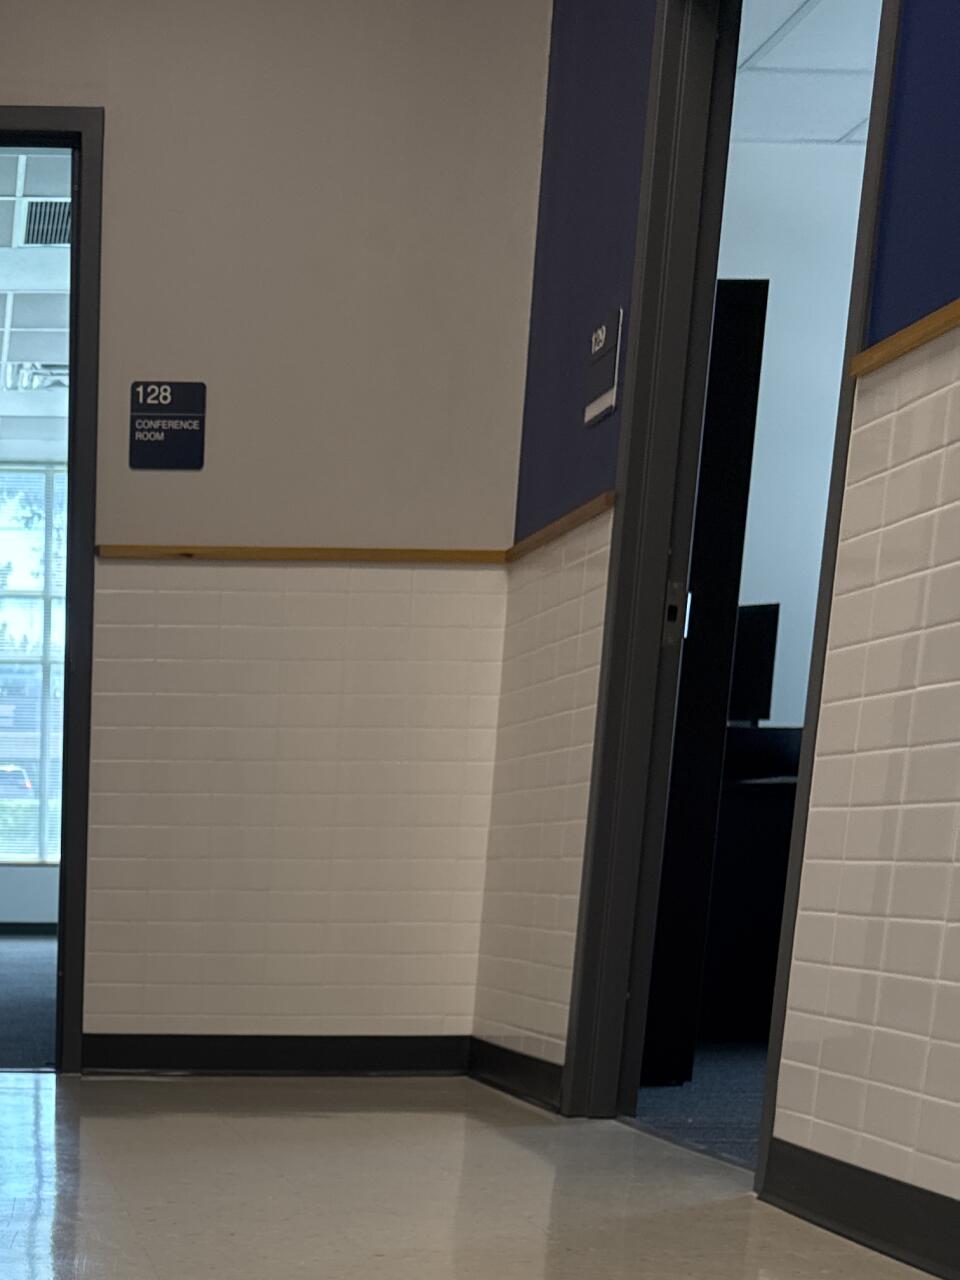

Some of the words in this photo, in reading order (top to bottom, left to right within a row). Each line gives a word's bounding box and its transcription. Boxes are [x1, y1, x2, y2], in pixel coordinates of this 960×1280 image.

[136, 384, 172, 404] 128
[135, 420, 200, 430] CONFERENCE
[135, 431, 165, 441] ROOM
